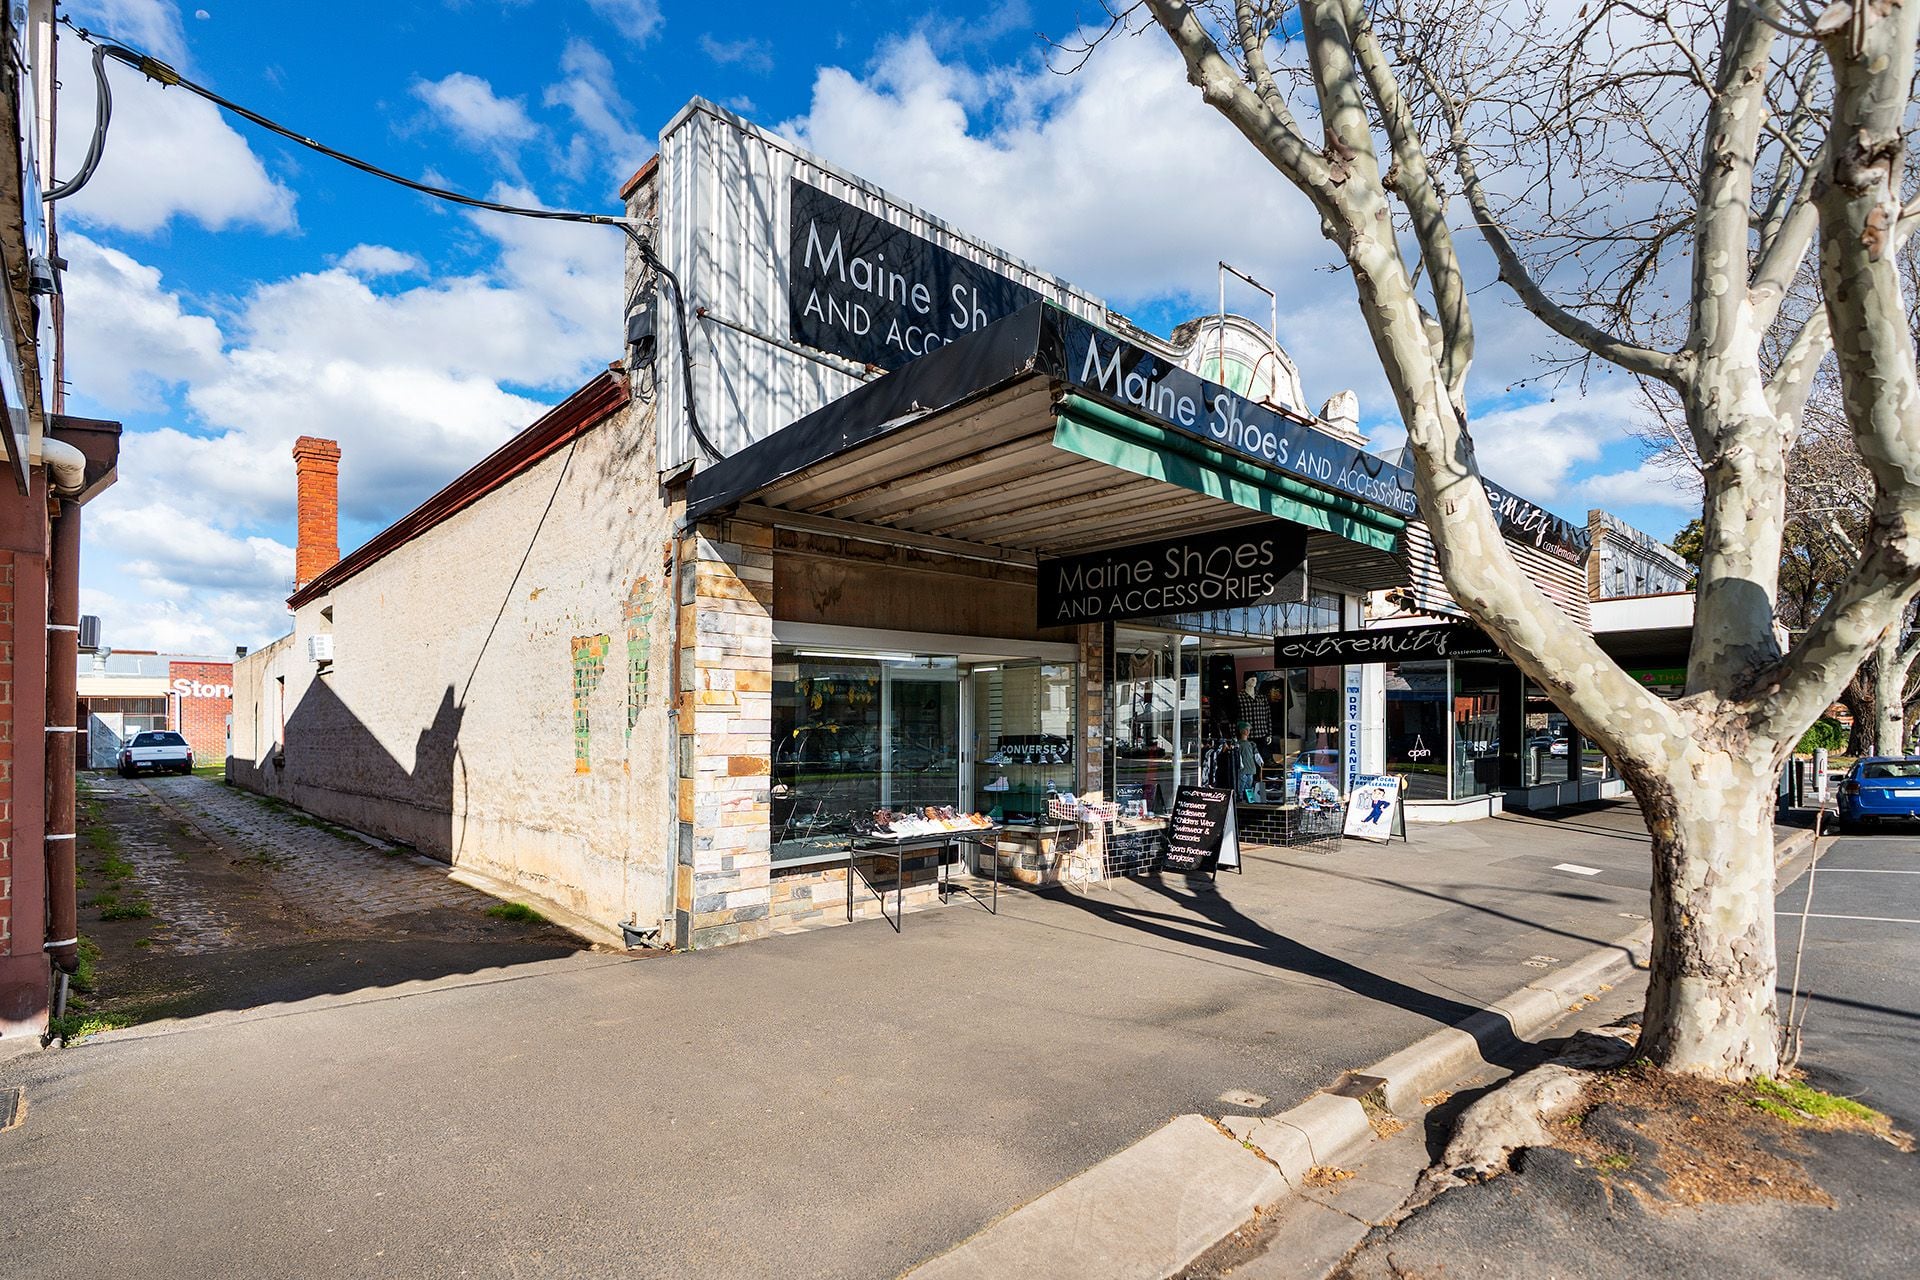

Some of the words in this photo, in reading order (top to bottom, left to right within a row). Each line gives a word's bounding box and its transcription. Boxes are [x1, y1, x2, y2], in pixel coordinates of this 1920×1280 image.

[804, 218, 931, 314] Maine
[803, 287, 871, 336] AND
[1080, 333, 1196, 427] Maine
[1210, 394, 1289, 465] Shoes
[1295, 449, 1332, 481] AND
[1337, 466, 1416, 514] ACCESSORIES
[1058, 558, 1153, 594] Maine
[1164, 540, 1274, 580] Shoes
[1057, 596, 1101, 619] AND
[1109, 573, 1275, 614] ACCESSORIES
[1282, 630, 1450, 658] extremity
[1349, 697, 1357, 720] DRY
[1000, 744, 1057, 755] CONVERSE
[1408, 749, 1431, 761] open
[1200, 819, 1216, 827] Wear
